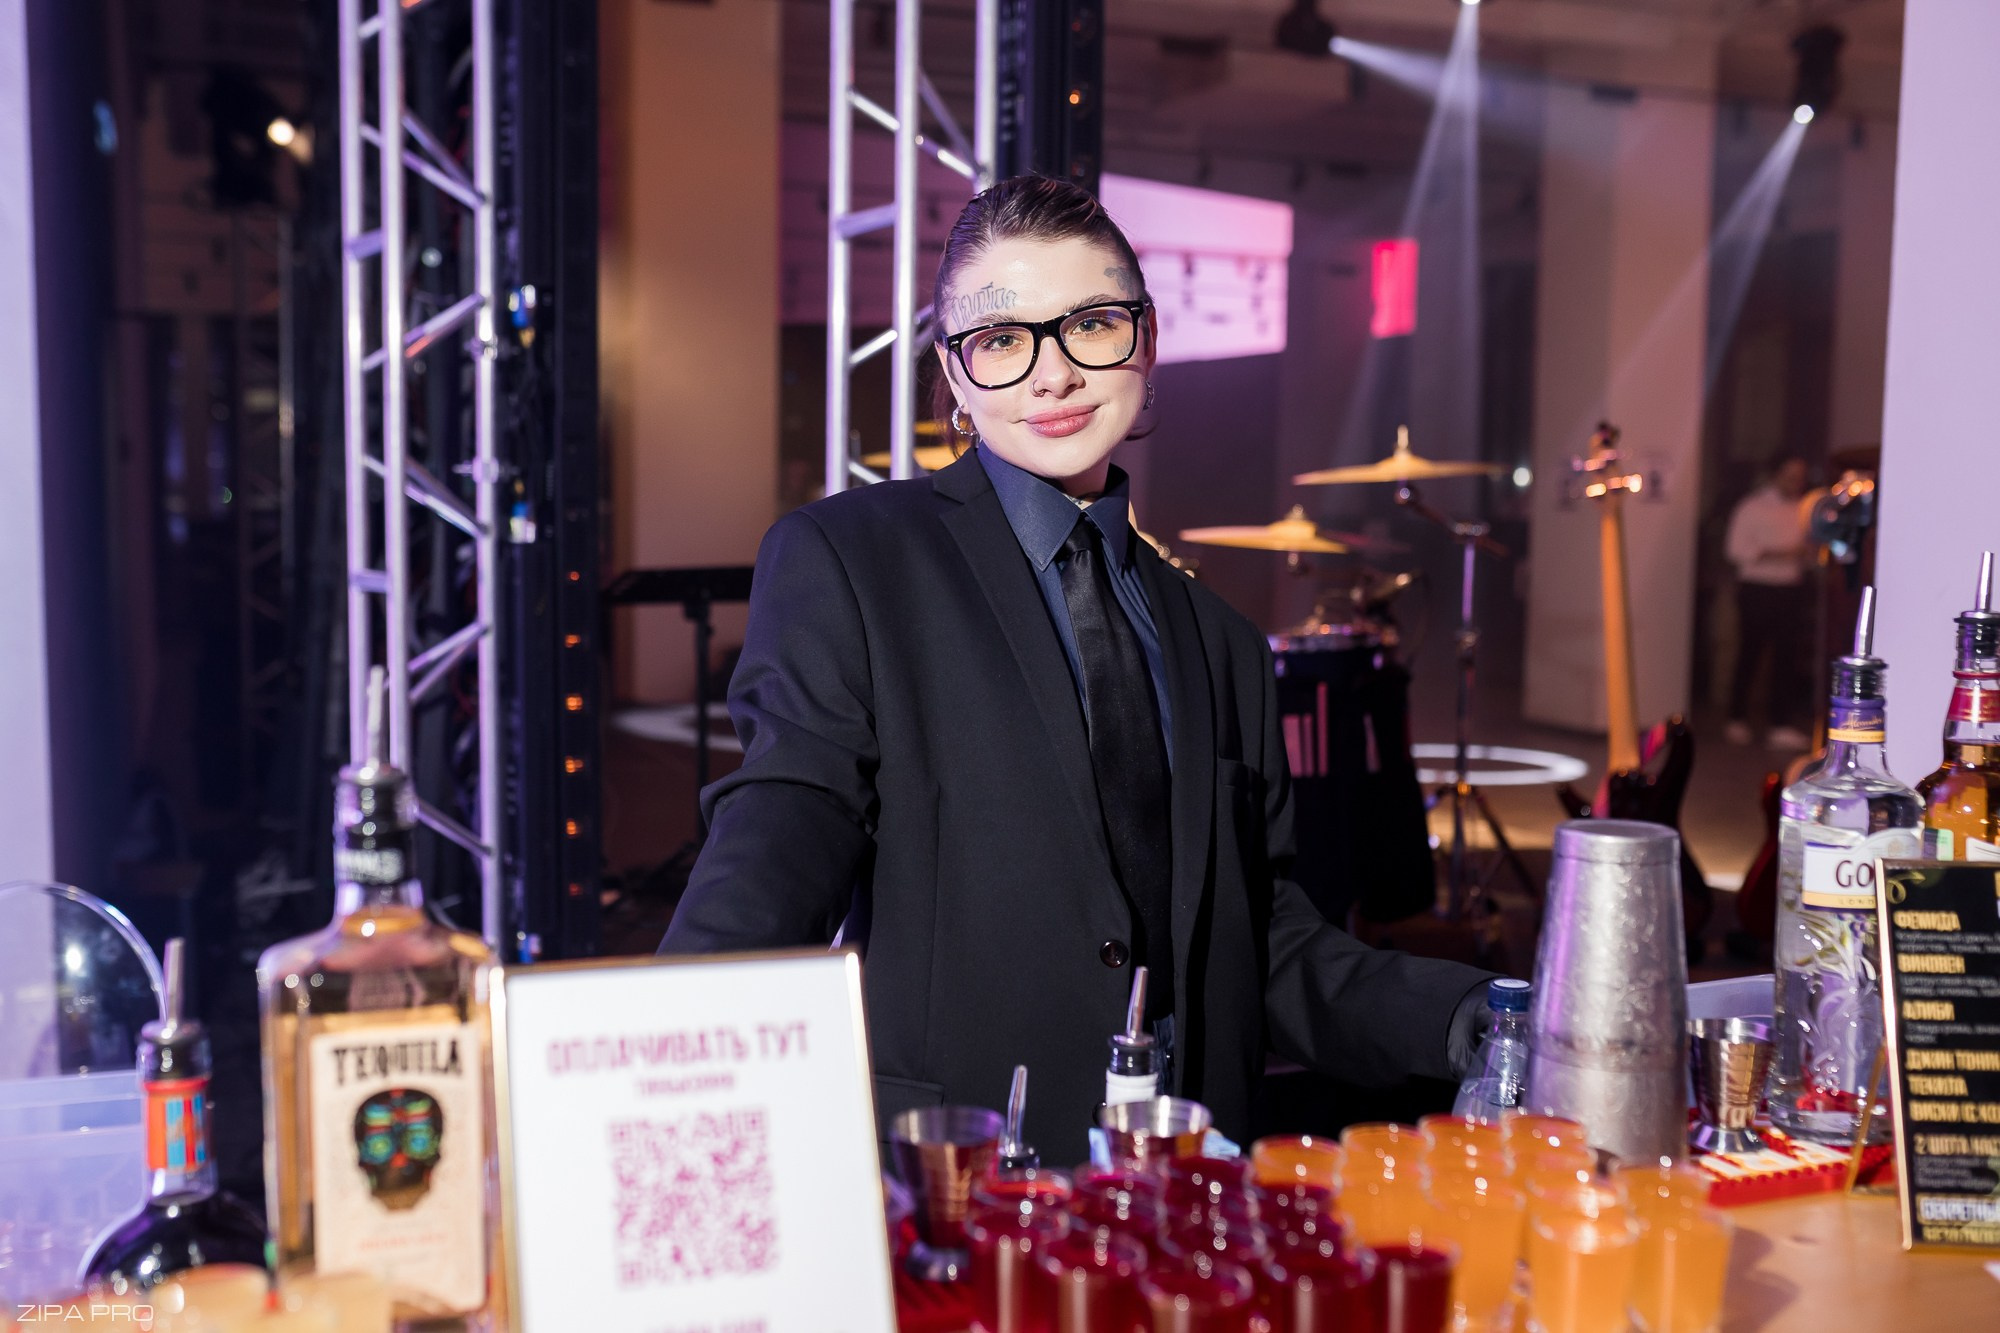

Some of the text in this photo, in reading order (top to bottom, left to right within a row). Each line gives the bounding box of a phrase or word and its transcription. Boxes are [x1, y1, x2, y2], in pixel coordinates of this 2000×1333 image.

[1893, 910, 1961, 931] ФЕМИДА
[1897, 954, 1966, 974] ВИНОВЕН
[1903, 1001, 1955, 1021] АЛИБИ
[547, 1020, 808, 1075] ОПЛАЧИВАТЬ ТУТ
[333, 1039, 463, 1085] TEQUILA
[1906, 1048, 1955, 1071] ДЖИН
[1907, 1074, 1969, 1096] ТЕКИЛА
[1909, 1100, 1959, 1122] ВИСКИ
